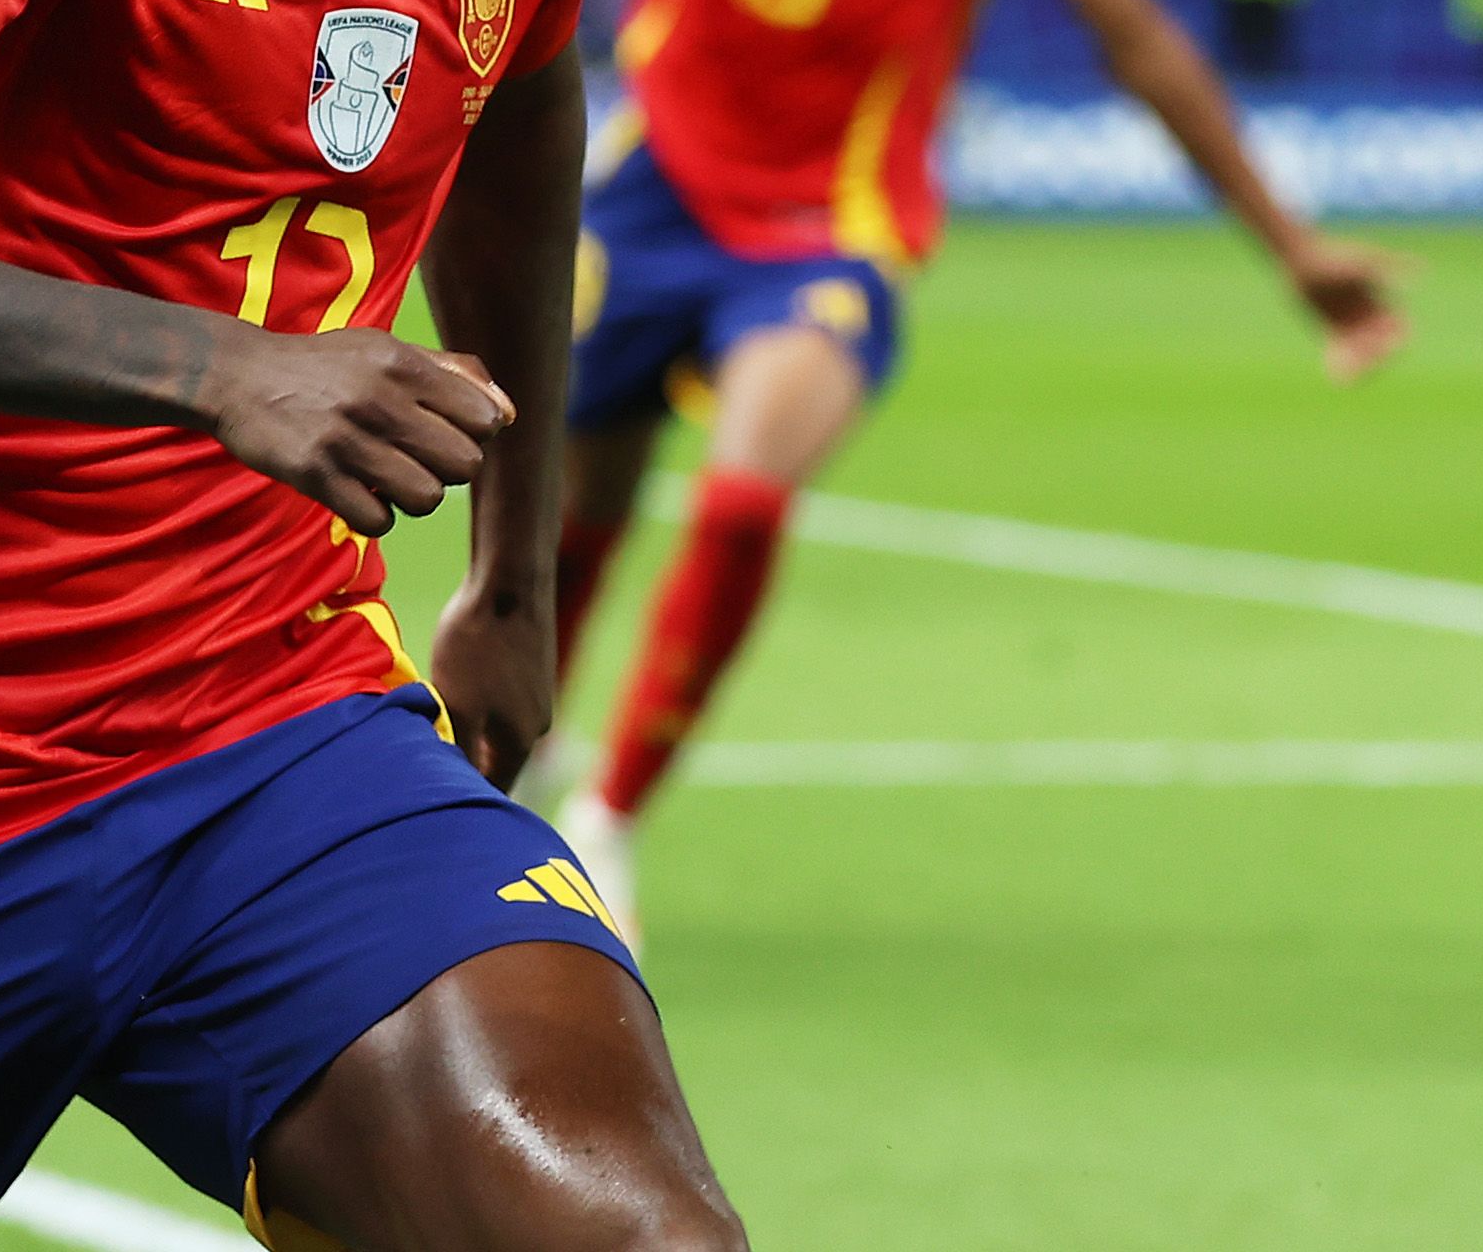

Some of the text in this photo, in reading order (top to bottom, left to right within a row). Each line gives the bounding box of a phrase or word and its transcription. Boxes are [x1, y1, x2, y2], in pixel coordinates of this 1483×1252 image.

[328, 16, 414, 35] UEFA NATIONS LEAGUE
[327, 145, 354, 166] WINNER
[220, 196, 375, 335] 17
